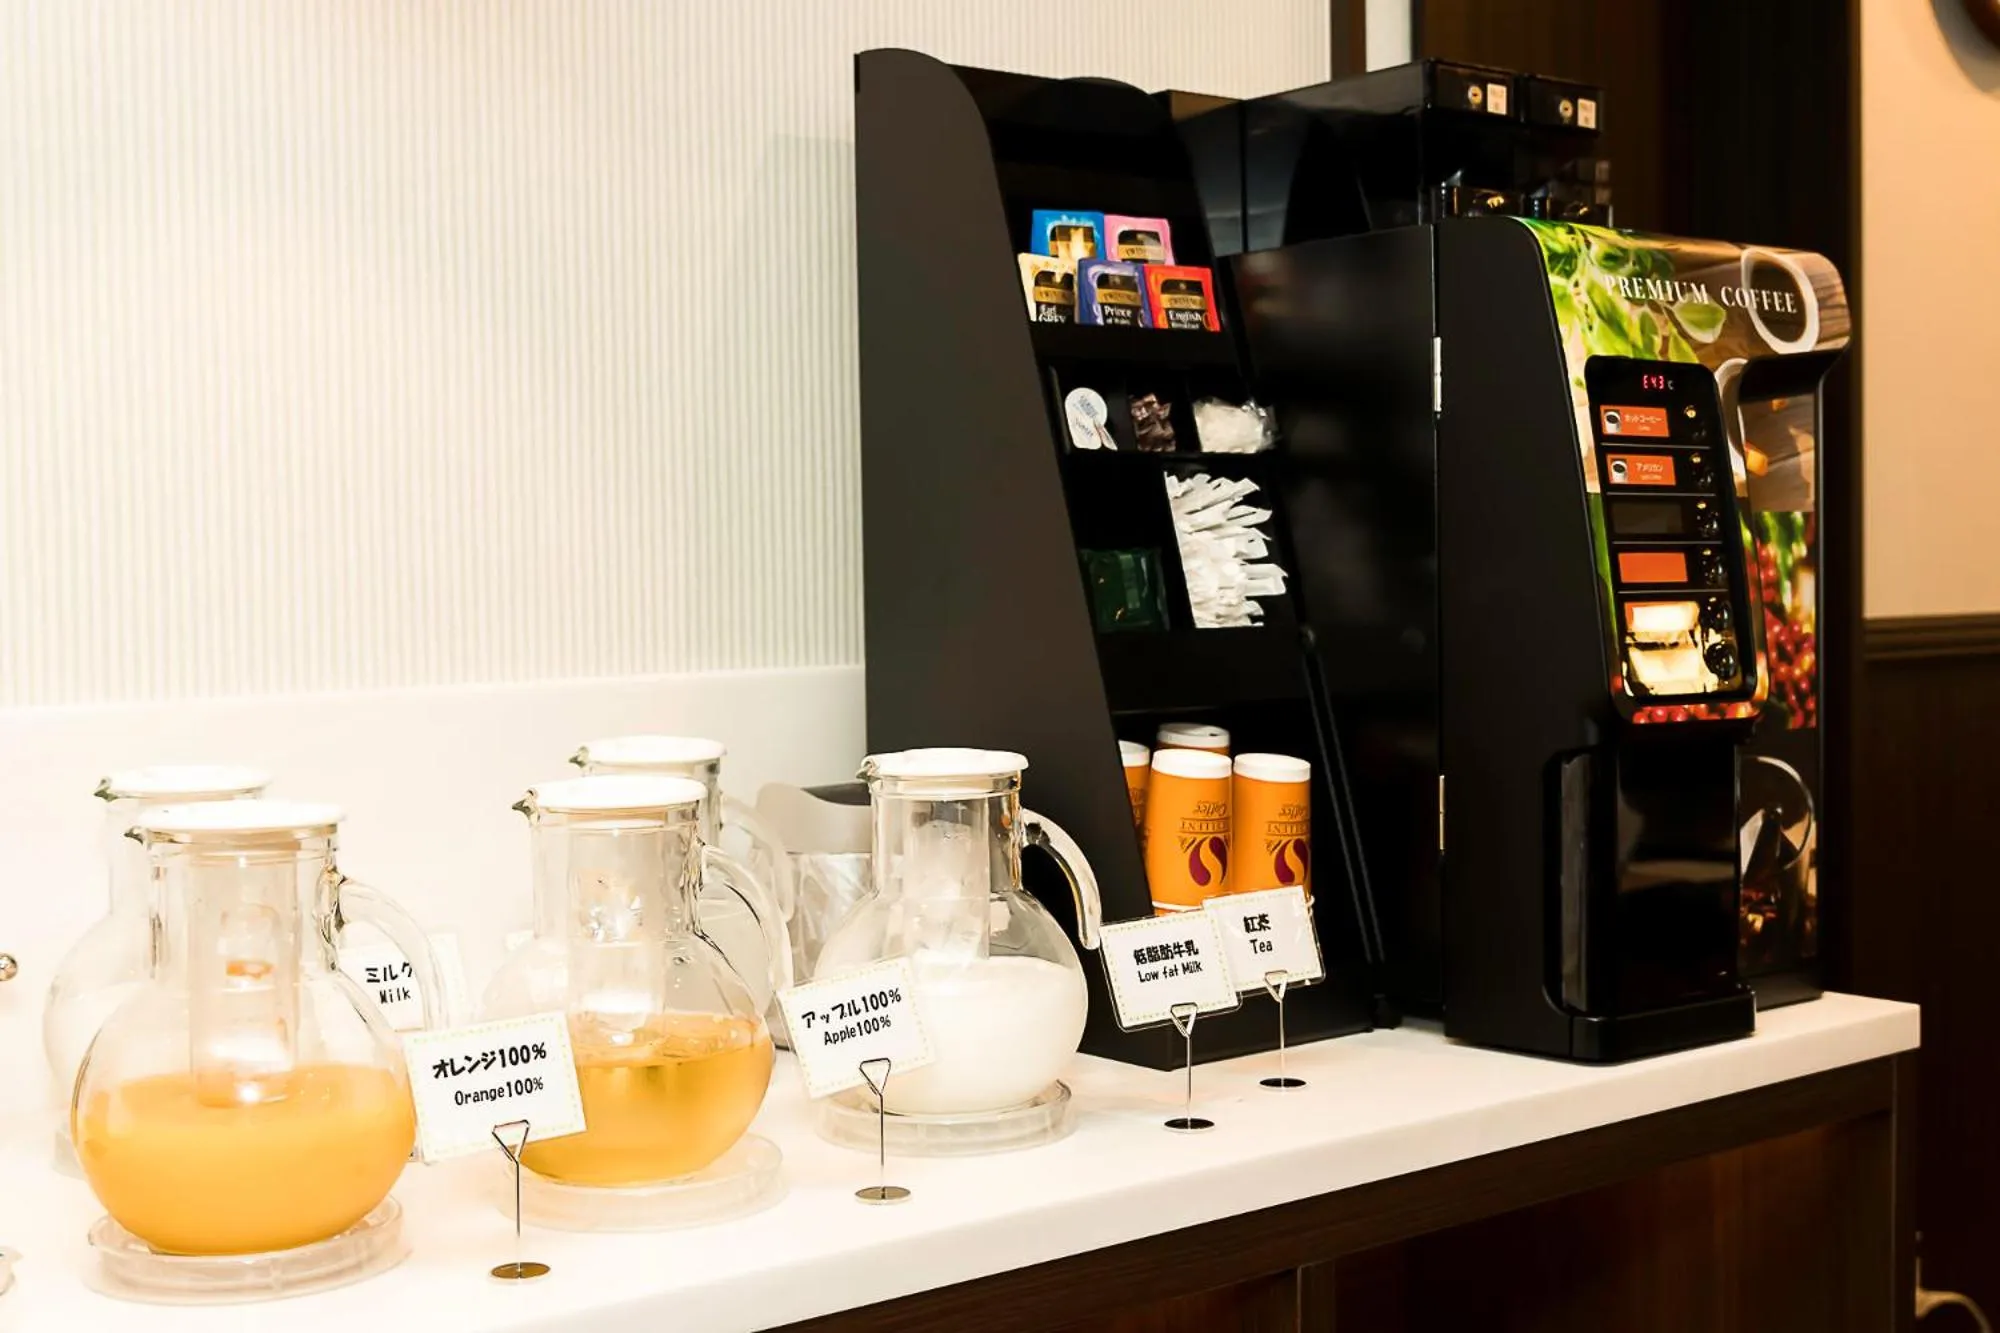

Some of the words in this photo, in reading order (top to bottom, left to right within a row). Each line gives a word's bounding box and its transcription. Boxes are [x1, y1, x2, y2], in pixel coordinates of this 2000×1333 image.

[1603, 275, 1708, 305] PREMIUM
[1720, 286, 1798, 314] COFFEE
[1168, 310, 1202, 323] English
[1243, 913, 1272, 934] 紅茶
[1133, 939, 1200, 966] 低脂肪牛乳
[1249, 938, 1273, 955] Tea
[365, 961, 413, 984] ミルク
[1137, 969, 1160, 984] Low
[1162, 964, 1179, 979] fat
[1182, 960, 1203, 976] Milk
[379, 987, 411, 1004] Milk
[801, 987, 902, 1028] アップル100%
[823, 1014, 892, 1046] Apple100%
[432, 1042, 547, 1079] オレンジ100%
[454, 1077, 544, 1106] Orange100%
